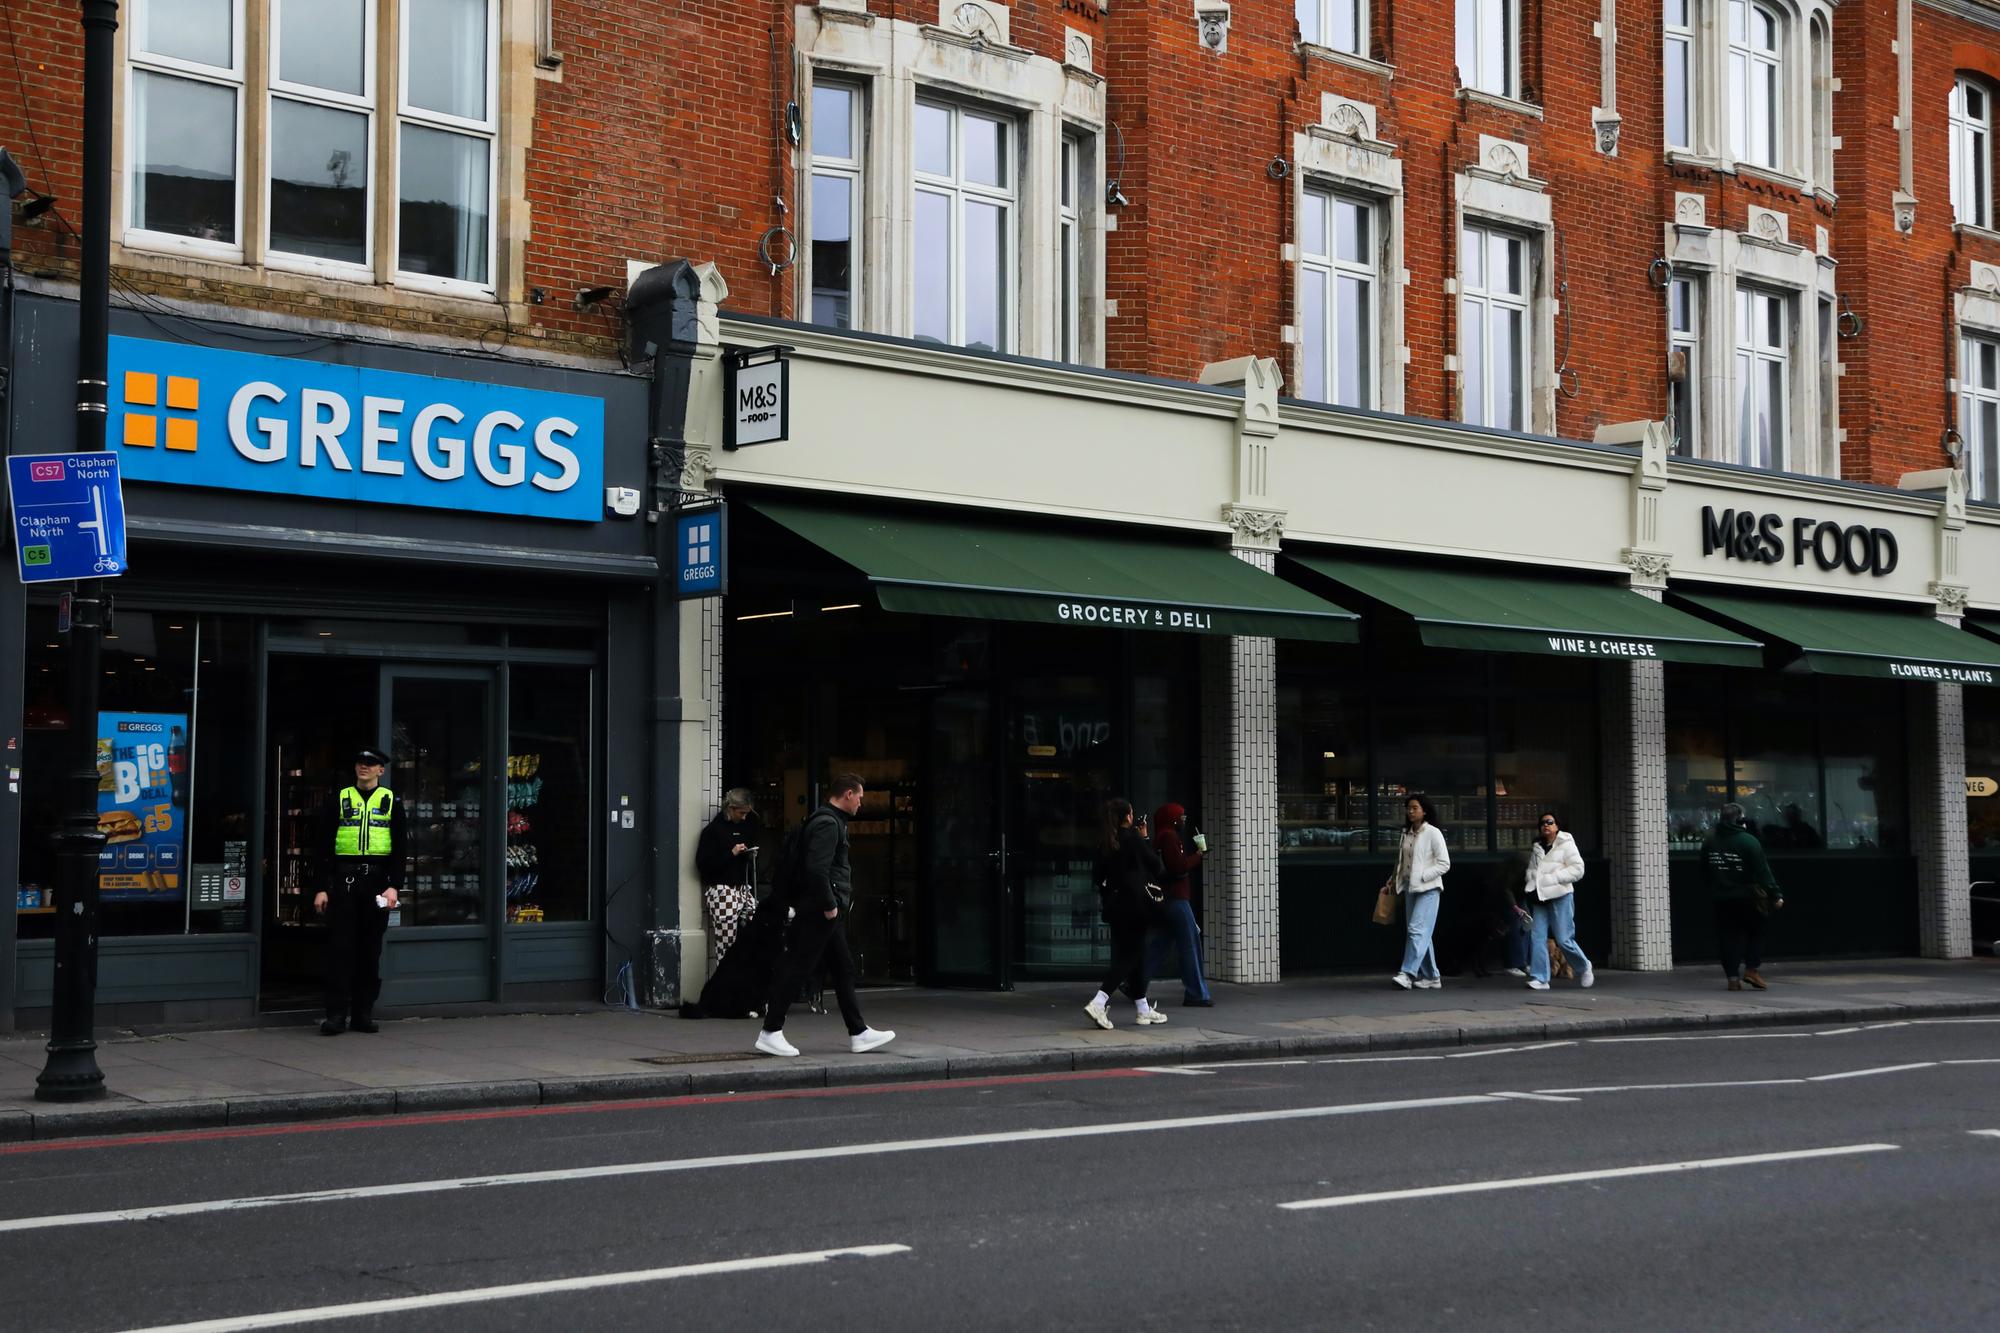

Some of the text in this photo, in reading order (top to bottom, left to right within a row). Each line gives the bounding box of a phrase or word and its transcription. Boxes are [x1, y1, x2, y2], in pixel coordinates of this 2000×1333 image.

[740, 383, 777, 412] M&S
[747, 412, 769, 423] FOOD
[228, 381, 580, 492] GREGGS
[67, 458, 116, 470] Clapham
[36, 466, 60, 477] CS7
[77, 469, 110, 479] North
[20, 515, 71, 528] Clapham
[30, 527, 64, 538] North
[1702, 505, 1899, 577] M&S FOOD
[28, 550, 46, 560] C5
[683, 565, 715, 581] GREGGS
[1058, 603, 1211, 629] GROCERY & DELI
[1548, 637, 1657, 657] WINE & CHEESE
[1890, 663, 1942, 679] FLOWERS
[1951, 668, 1993, 683] PLANTS
[128, 723, 163, 732] GREGGS
[113, 746, 135, 761] THE
[1965, 781, 1985, 792] VEG
[142, 787, 169, 800] DEAL
[145, 803, 172, 833] £5
